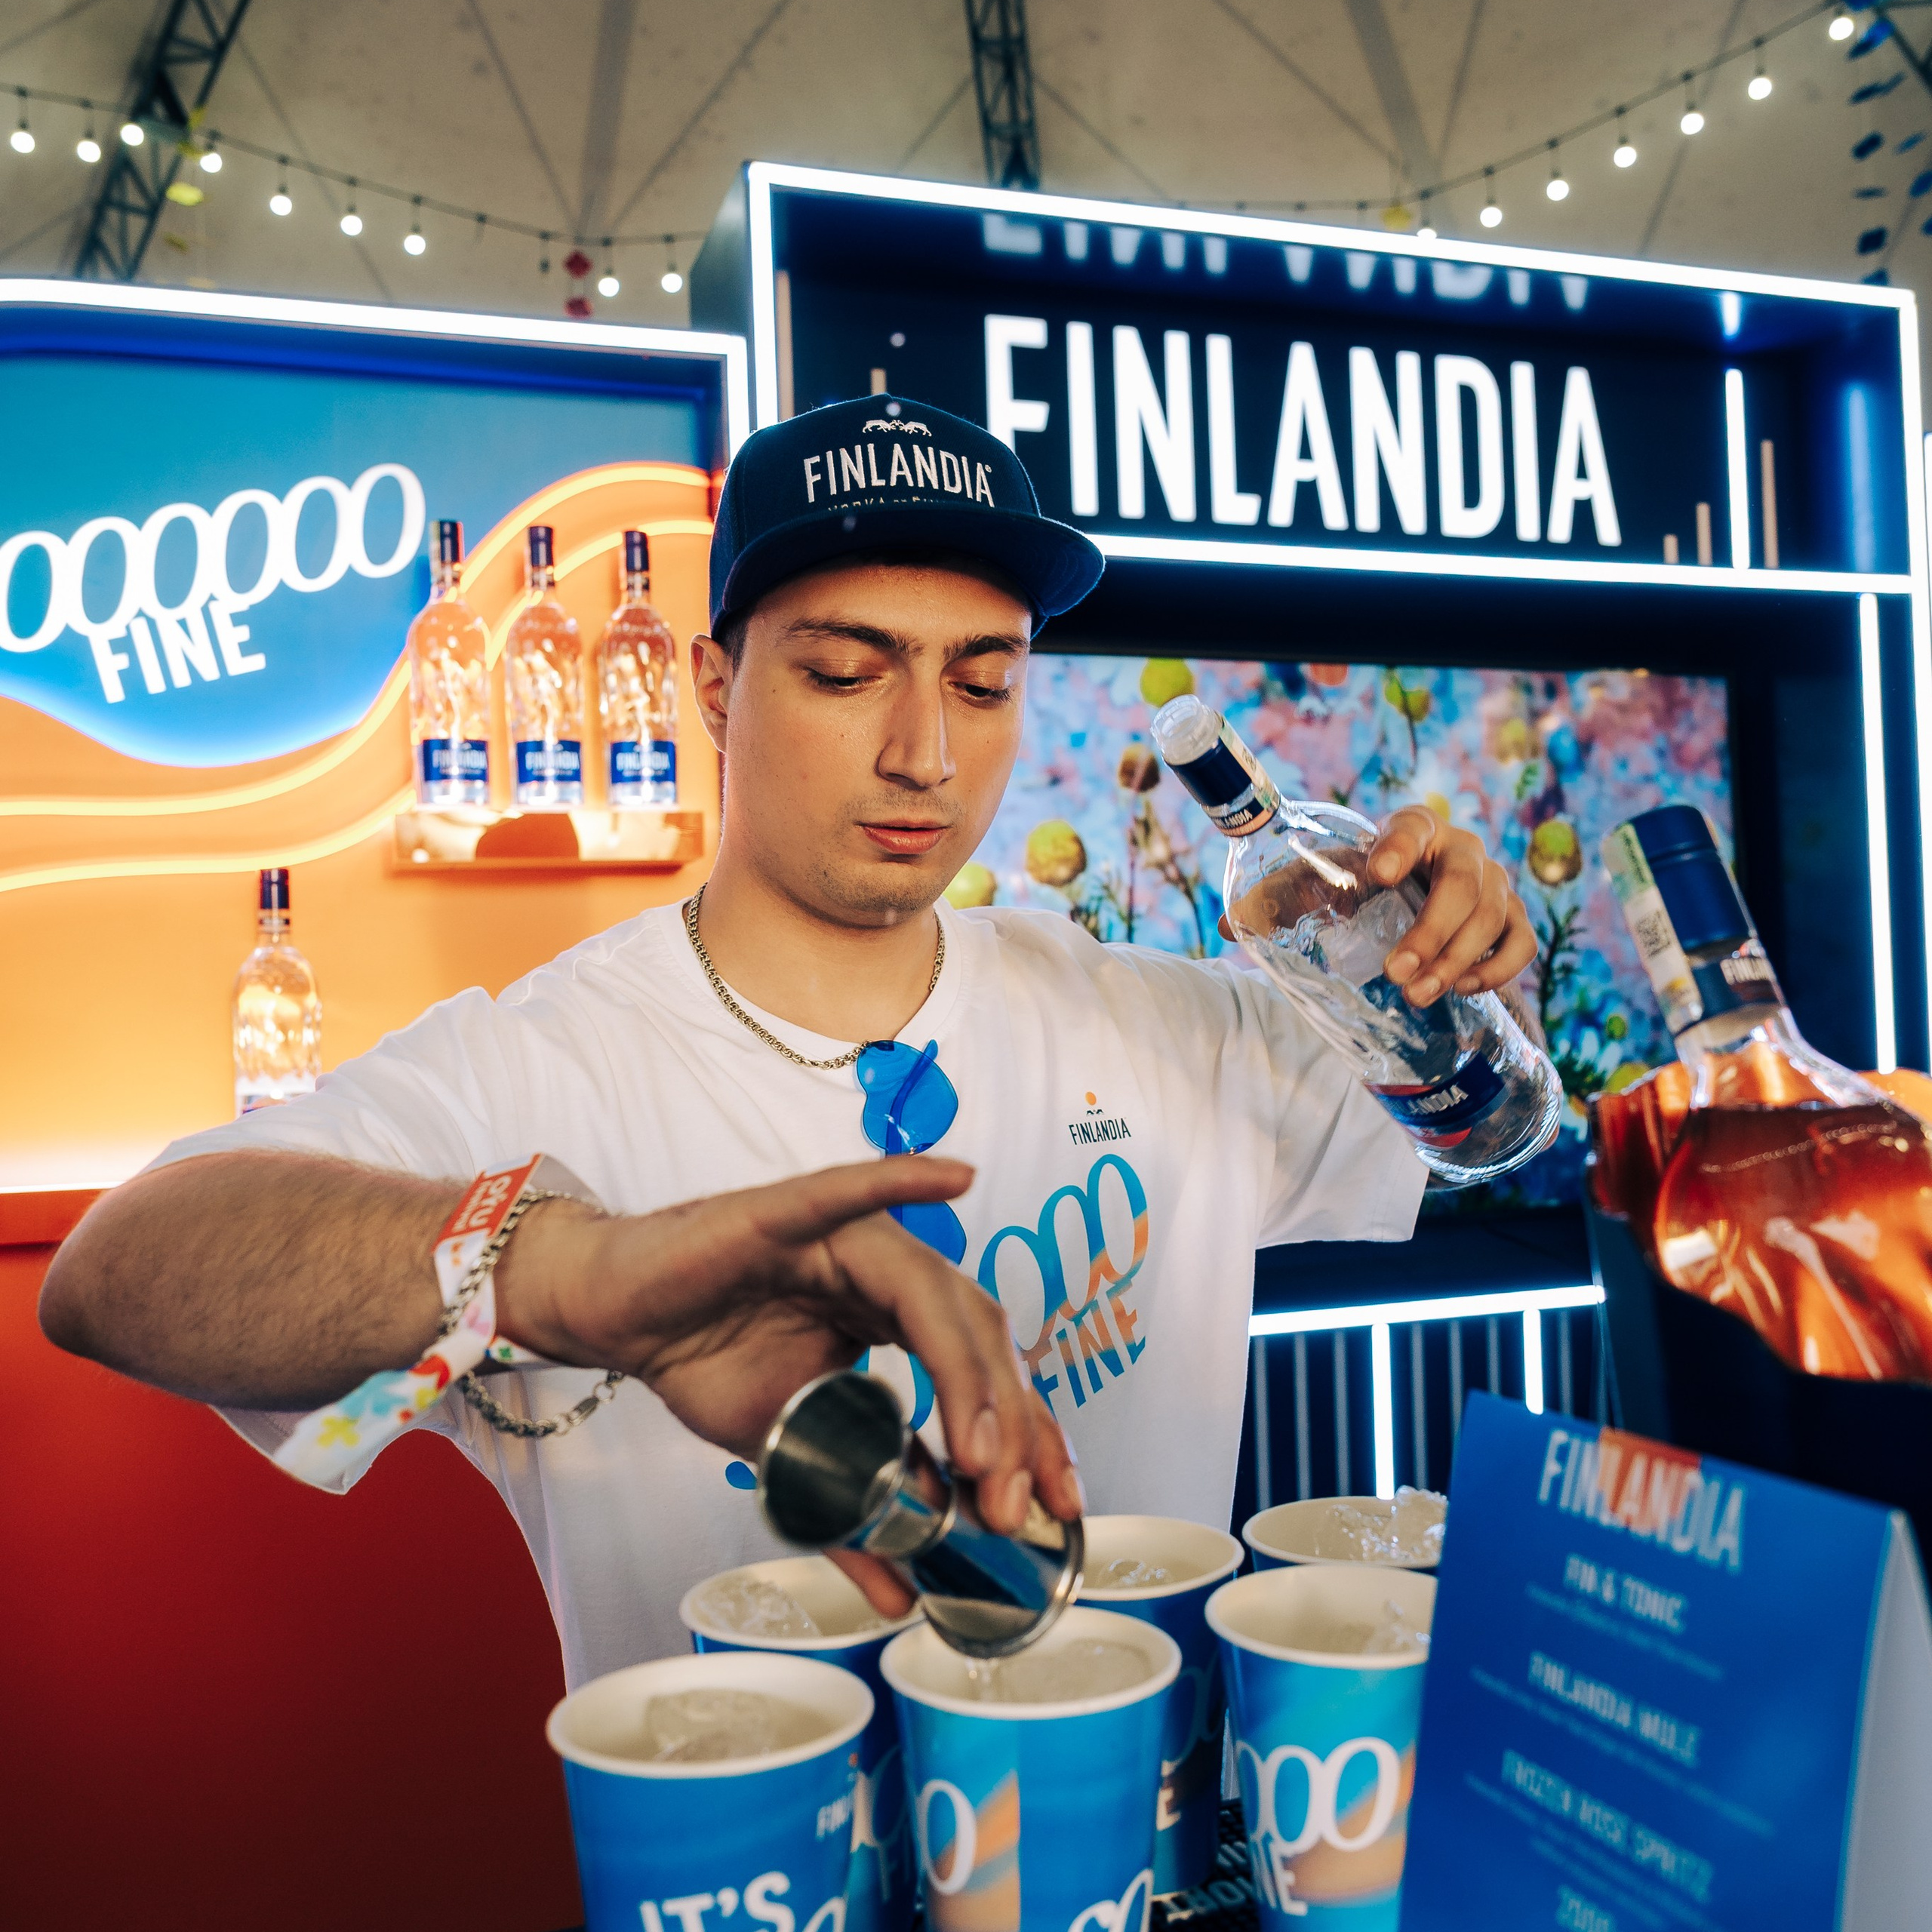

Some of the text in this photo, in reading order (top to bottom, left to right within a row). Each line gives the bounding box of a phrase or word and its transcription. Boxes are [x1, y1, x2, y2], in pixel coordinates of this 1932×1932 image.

[983, 312, 1622, 547] FINLANDIA
[88, 599, 266, 704] FINE
[1068, 1117, 1132, 1146] FINLANDIA
[1020, 1281, 1146, 1417] FINE
[1538, 1429, 1744, 1570] FINLANDIA
